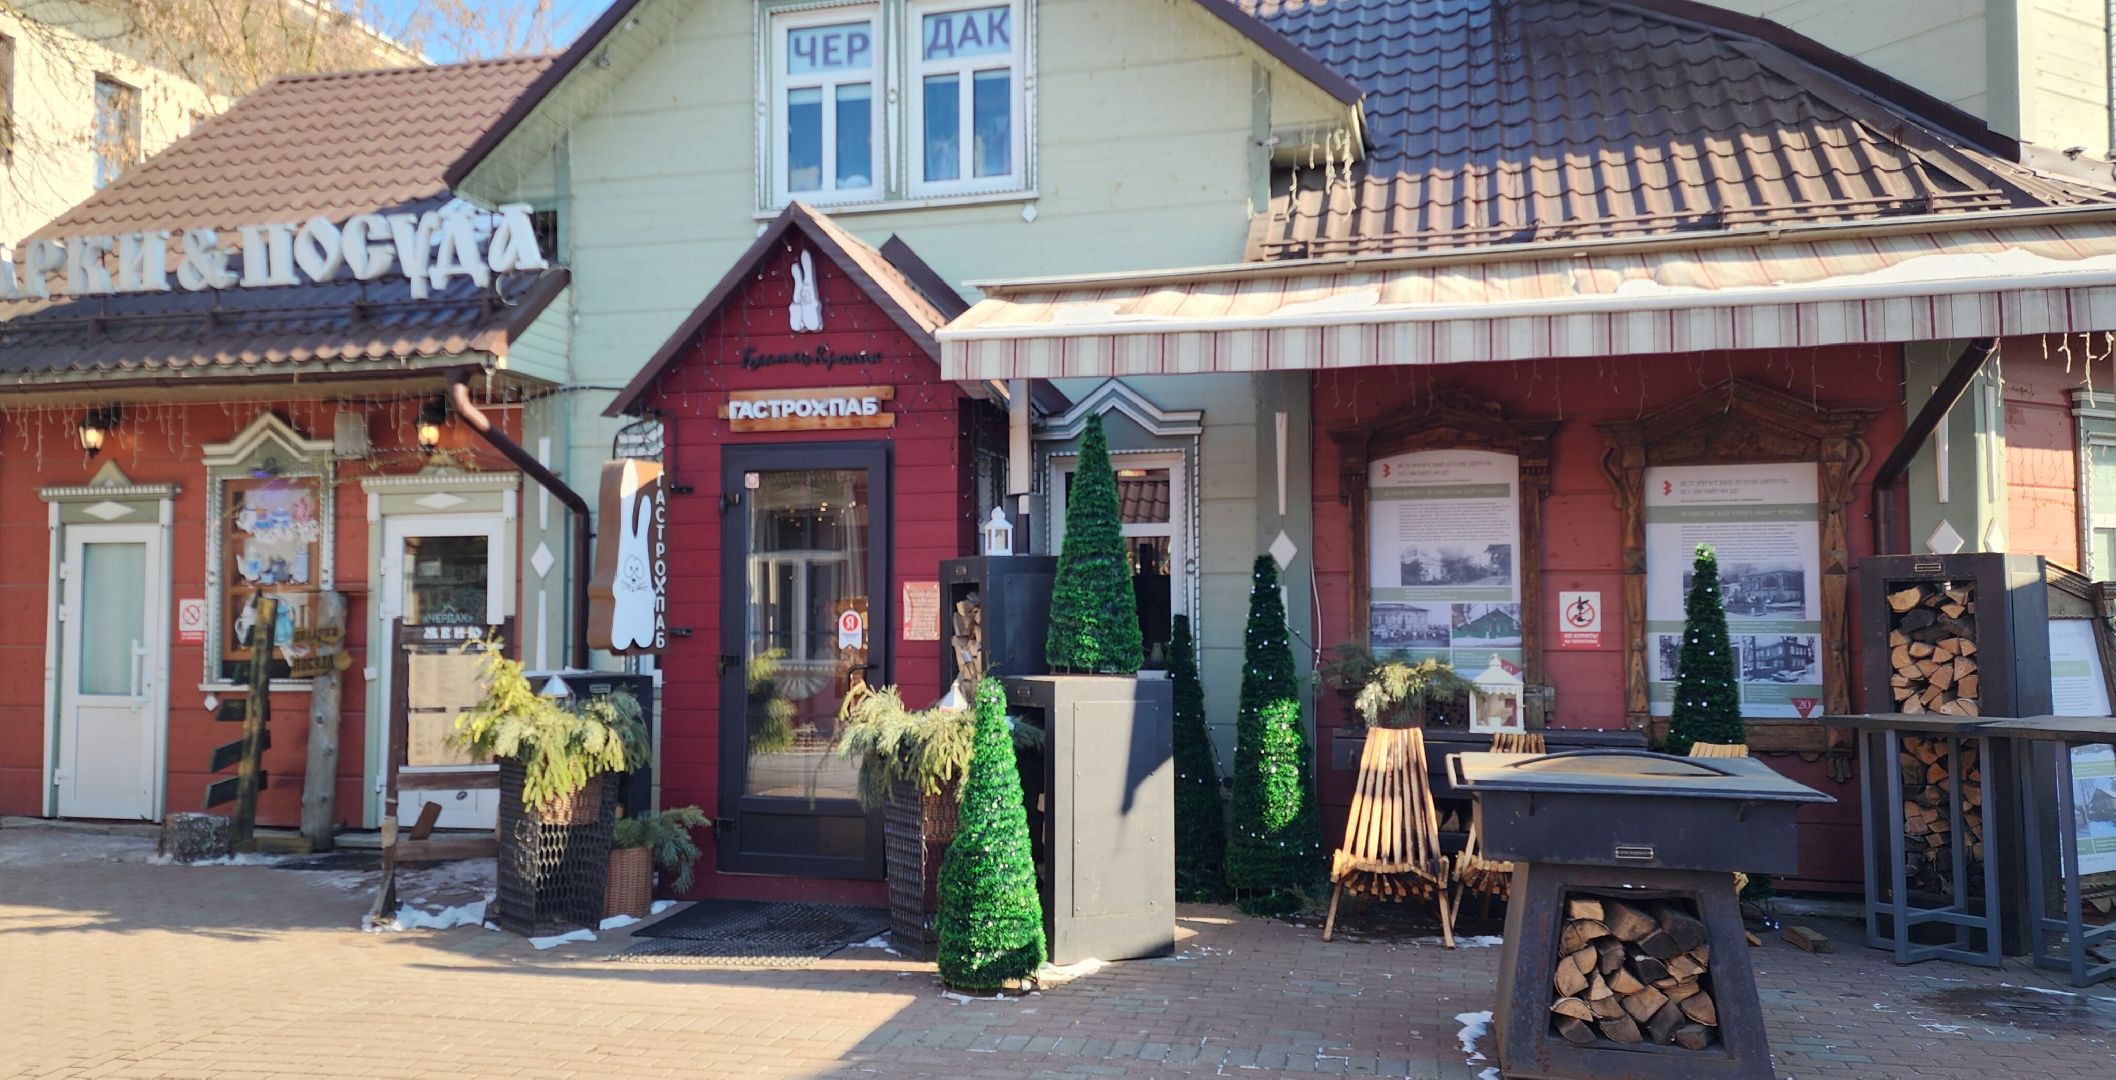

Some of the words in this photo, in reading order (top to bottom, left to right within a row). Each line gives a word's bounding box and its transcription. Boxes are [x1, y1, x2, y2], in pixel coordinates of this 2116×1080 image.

[794, 33, 870, 67] ЧЕР
[926, 9, 1010, 60] ДАК
[729, 396, 879, 420] ГАСТРОХПАБ
[1798, 700, 1811, 710] 20
